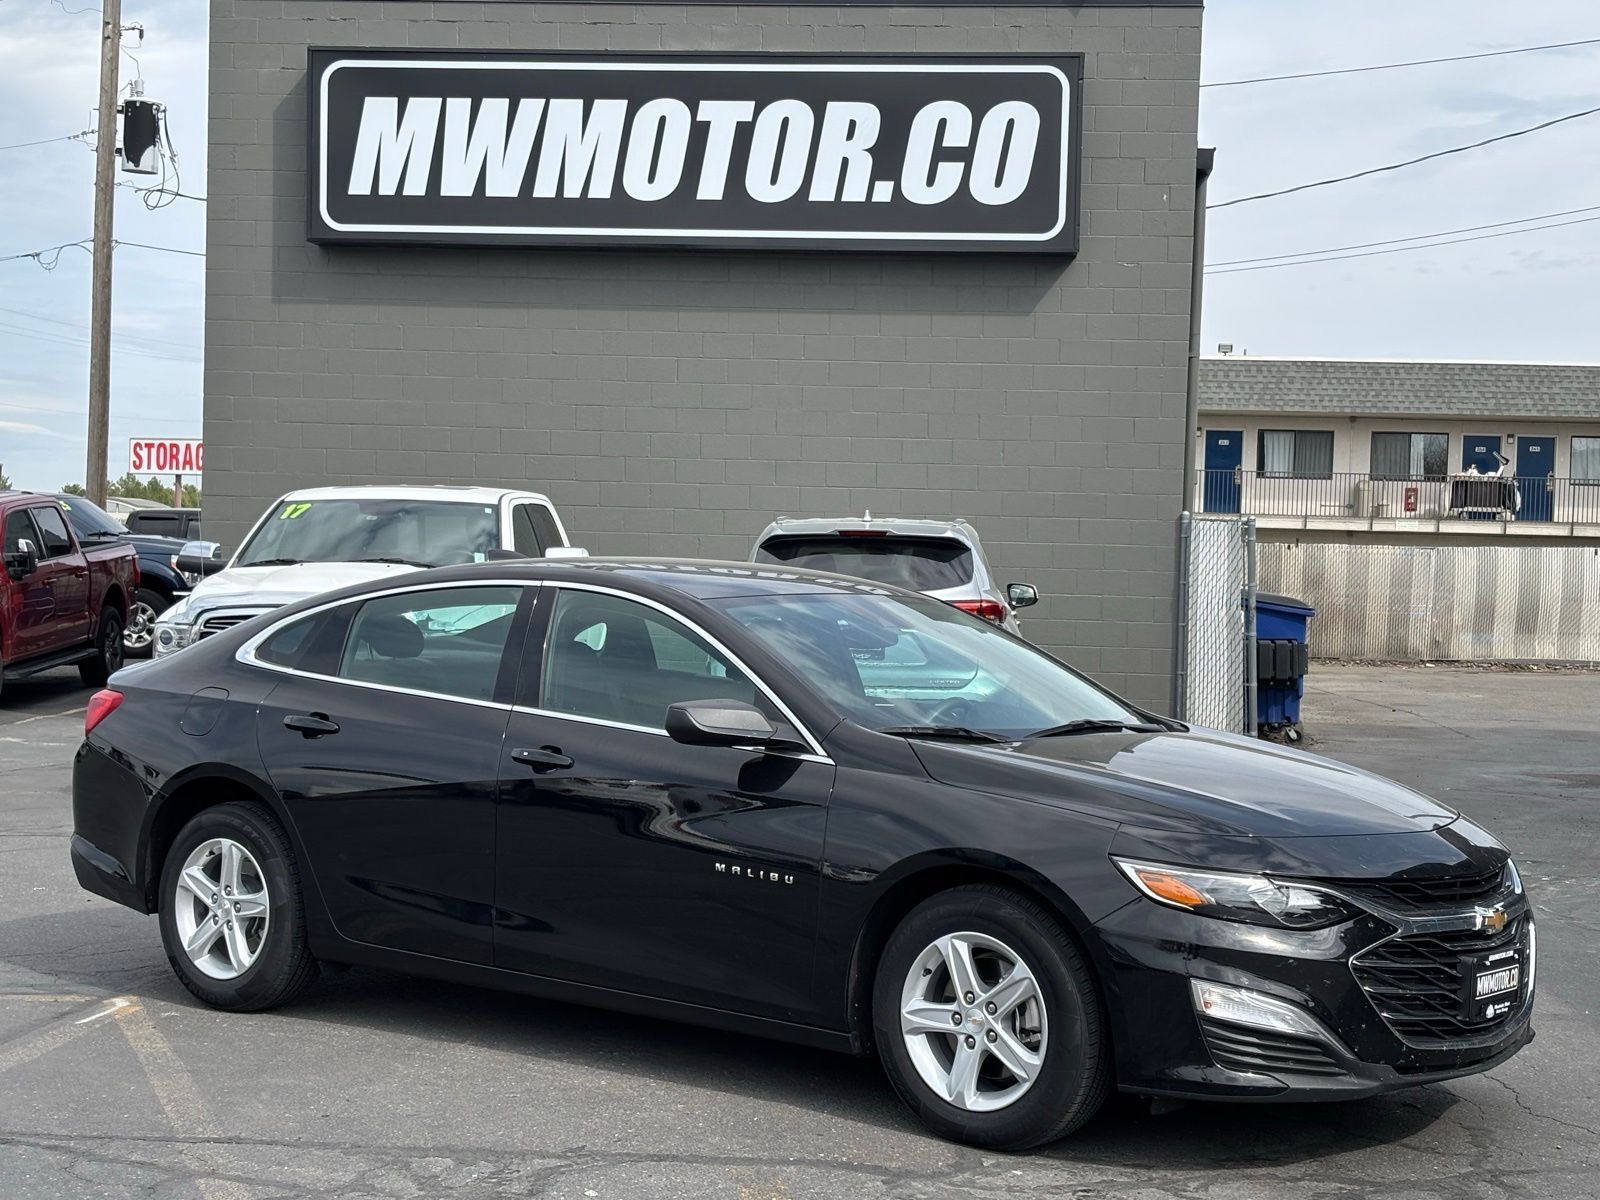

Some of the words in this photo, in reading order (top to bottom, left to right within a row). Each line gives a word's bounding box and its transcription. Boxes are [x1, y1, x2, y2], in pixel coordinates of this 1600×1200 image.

[348, 97, 1041, 205] MWMOTOR.CO
[280, 503, 312, 519] 17
[715, 863, 794, 884] MALIBU
[1476, 967, 1519, 996] MWMOTOR.CO
